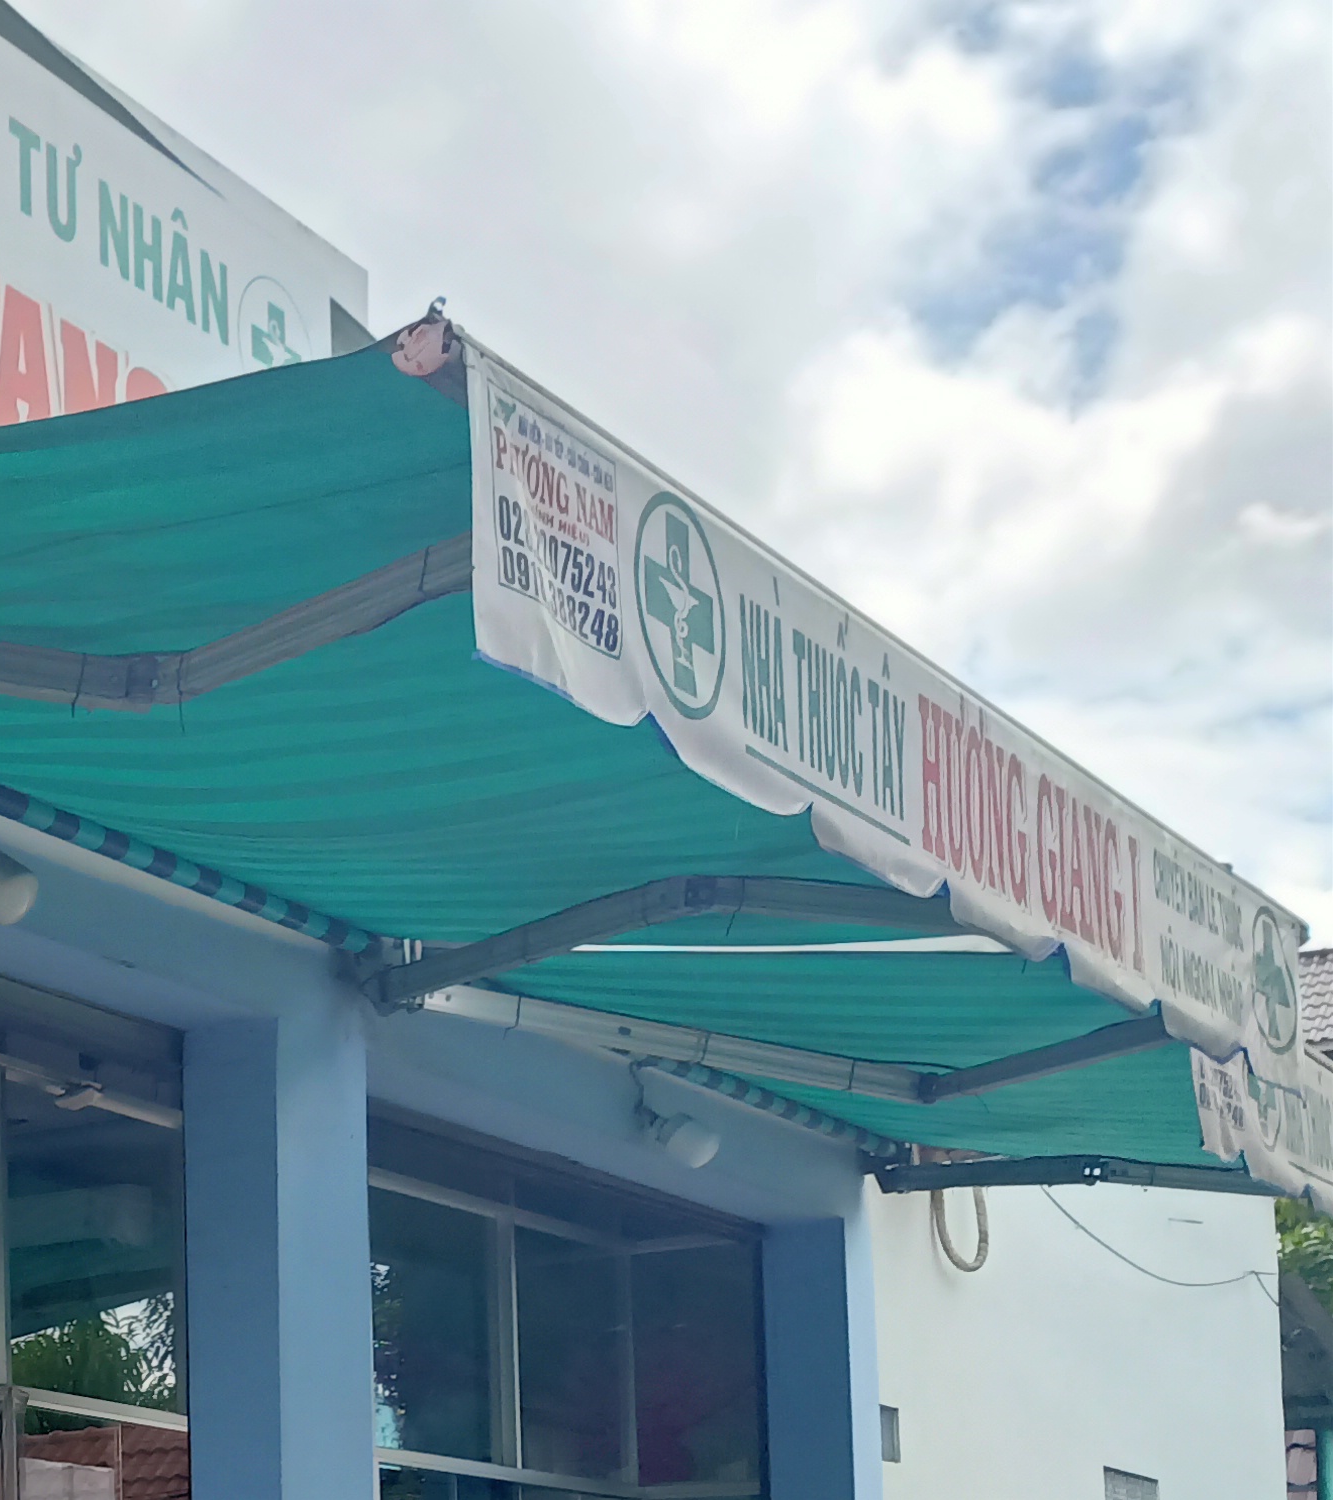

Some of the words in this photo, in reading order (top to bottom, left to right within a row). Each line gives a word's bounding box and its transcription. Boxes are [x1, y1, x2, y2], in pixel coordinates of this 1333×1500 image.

[8, 116, 82, 245] TƯ
[97, 178, 230, 347] NHÂN
[574, 480, 615, 545] NAM
[739, 577, 790, 754] NHÀ
[792, 613, 863, 798] THUỐC
[867, 653, 907, 822] TÂY
[917, 692, 1030, 916] HƯƠNG
[1036, 772, 1125, 967] GIANG
